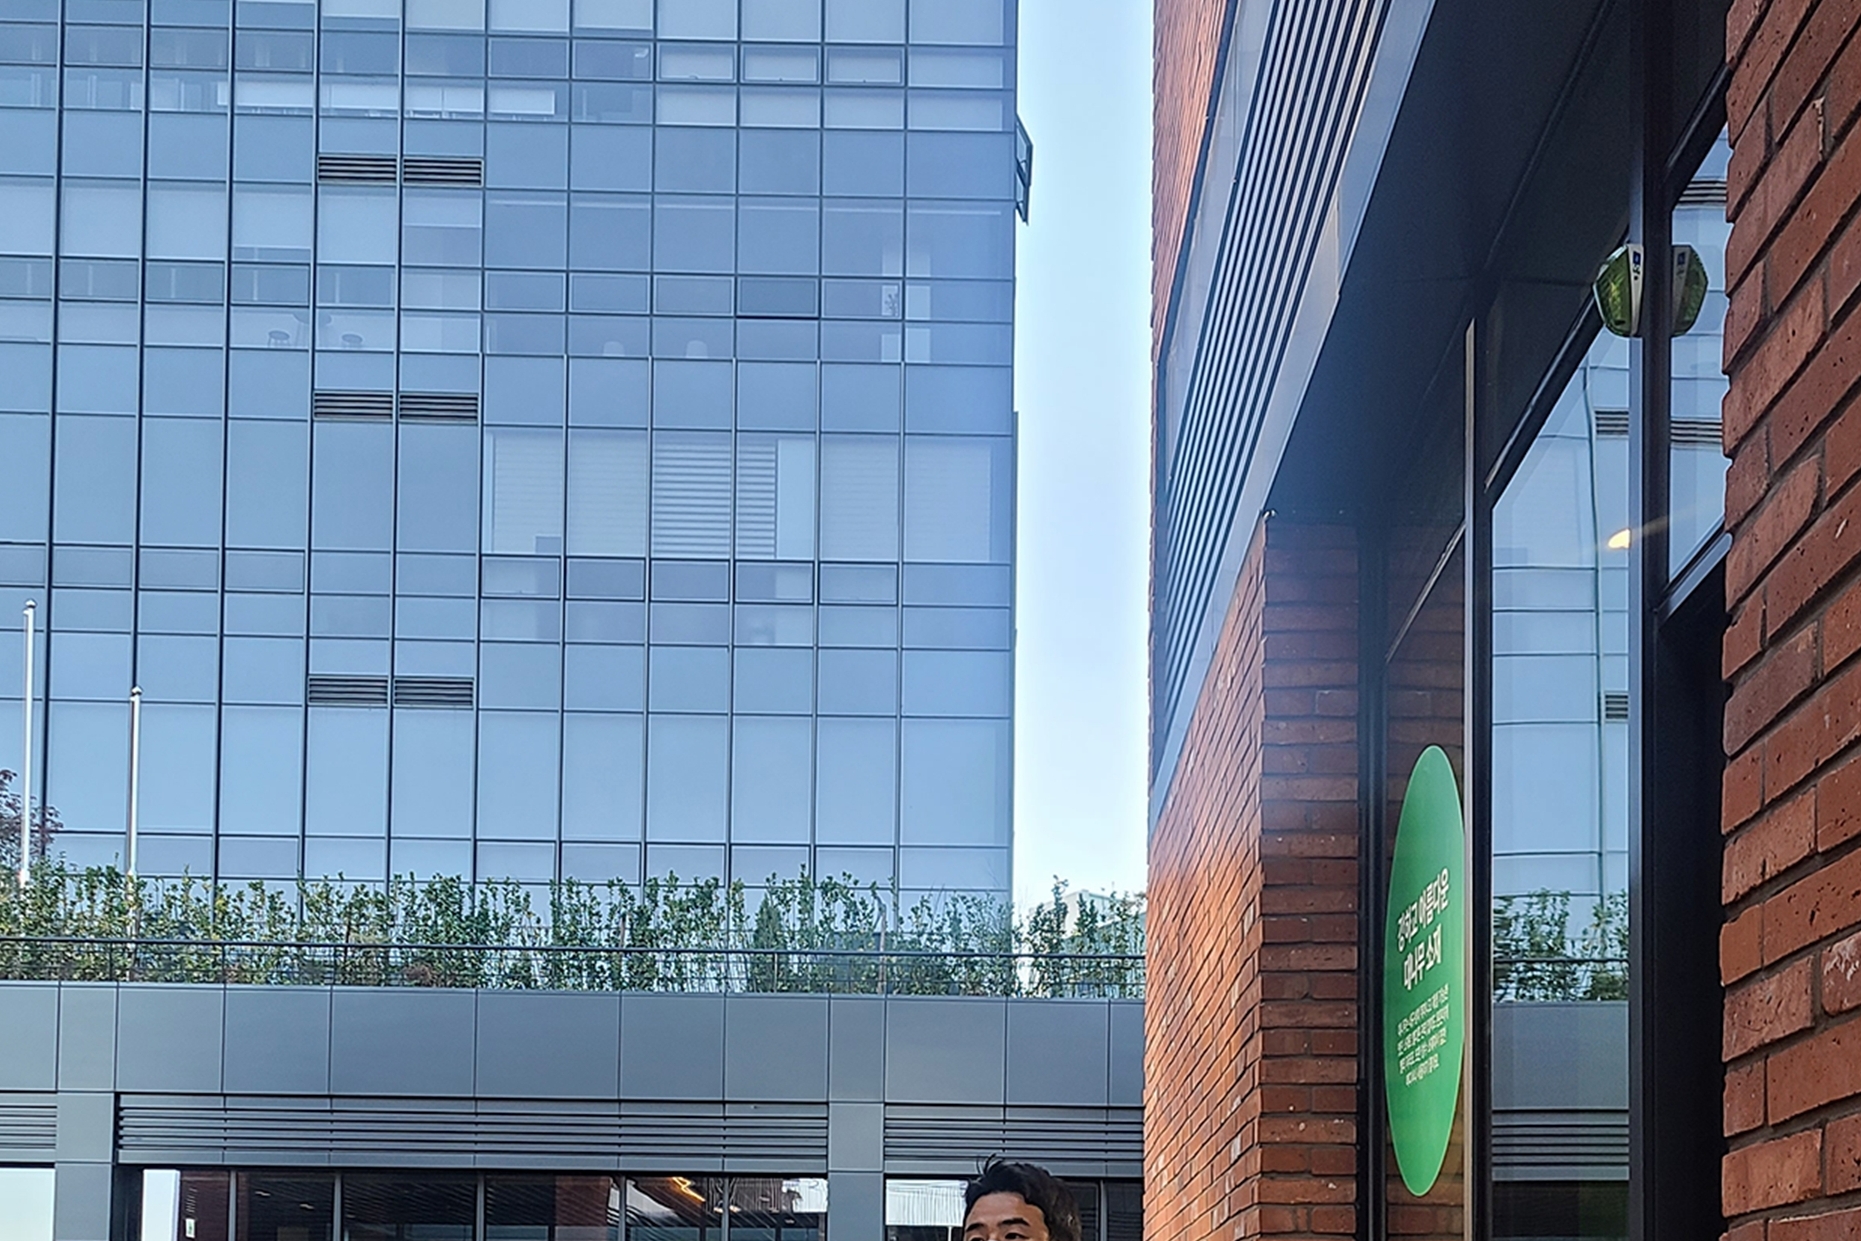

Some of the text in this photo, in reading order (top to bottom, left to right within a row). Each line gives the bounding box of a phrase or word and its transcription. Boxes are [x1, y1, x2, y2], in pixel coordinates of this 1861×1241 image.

[1418, 867, 1450, 929] 아름다운
[1404, 924, 1442, 991] 대나무 소재
